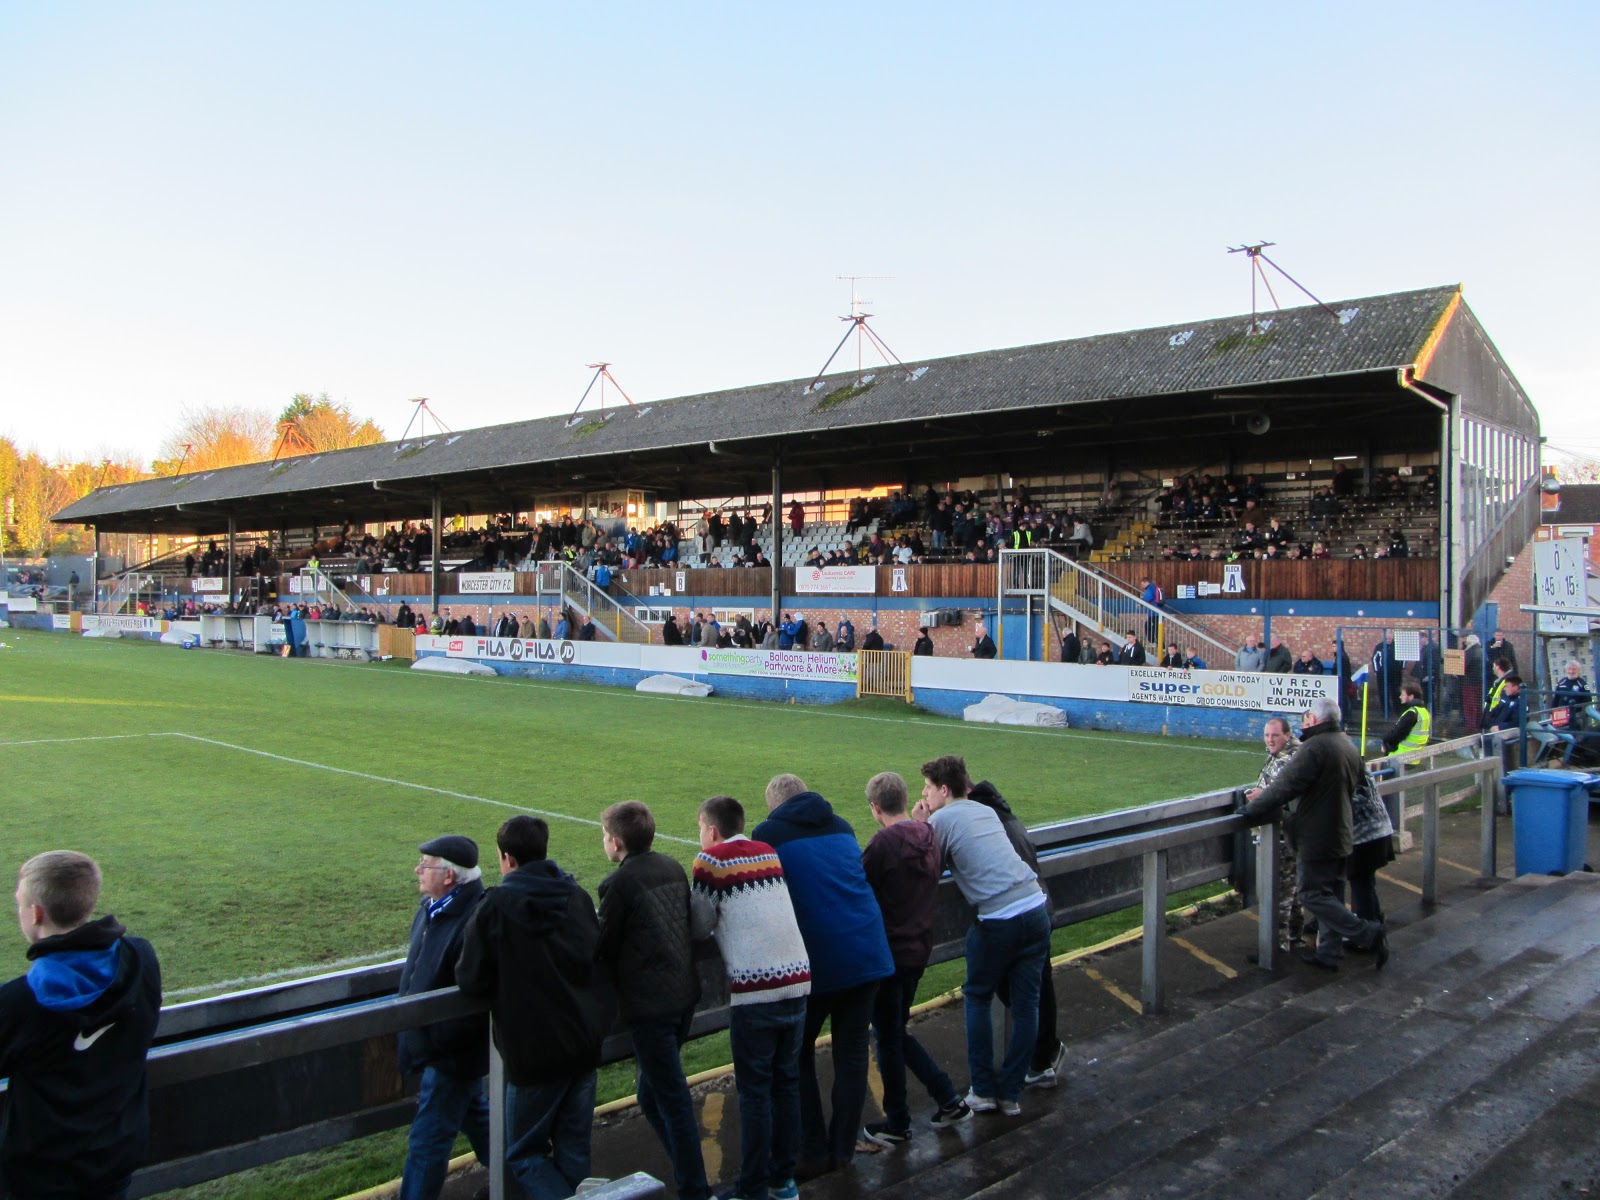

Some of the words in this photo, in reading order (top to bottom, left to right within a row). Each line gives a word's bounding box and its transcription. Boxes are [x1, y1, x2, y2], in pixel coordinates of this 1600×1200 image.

[462, 580, 489, 591] WORCESTER
[490, 580, 502, 591] CITY
[896, 576, 902, 591] A
[1228, 573, 1237, 591] A
[1545, 576, 1555, 596] 45
[1565, 575, 1575, 596] 15
[478, 640, 505, 657] FILA
[525, 642, 555, 660] FILA
[769, 652, 804, 665] Balloons,
[808, 654, 839, 666] Helium,
[764, 662, 805, 674] Partyware
[806, 664, 812, 673] &
[1130, 669, 1167, 679] EXCELLENT
[1168, 671, 1192, 680] PRIZES
[1219, 675, 1235, 683] JOIN
[1237, 675, 1261, 684] TODAY
[1272, 687, 1283, 696] IN
[1286, 688, 1326, 698] PRIZES
[1131, 693, 1157, 702] AGENTS
[1158, 694, 1186, 703] WANTED
[1216, 698, 1261, 709] COMMISSION
[1266, 697, 1295, 707] EACH
